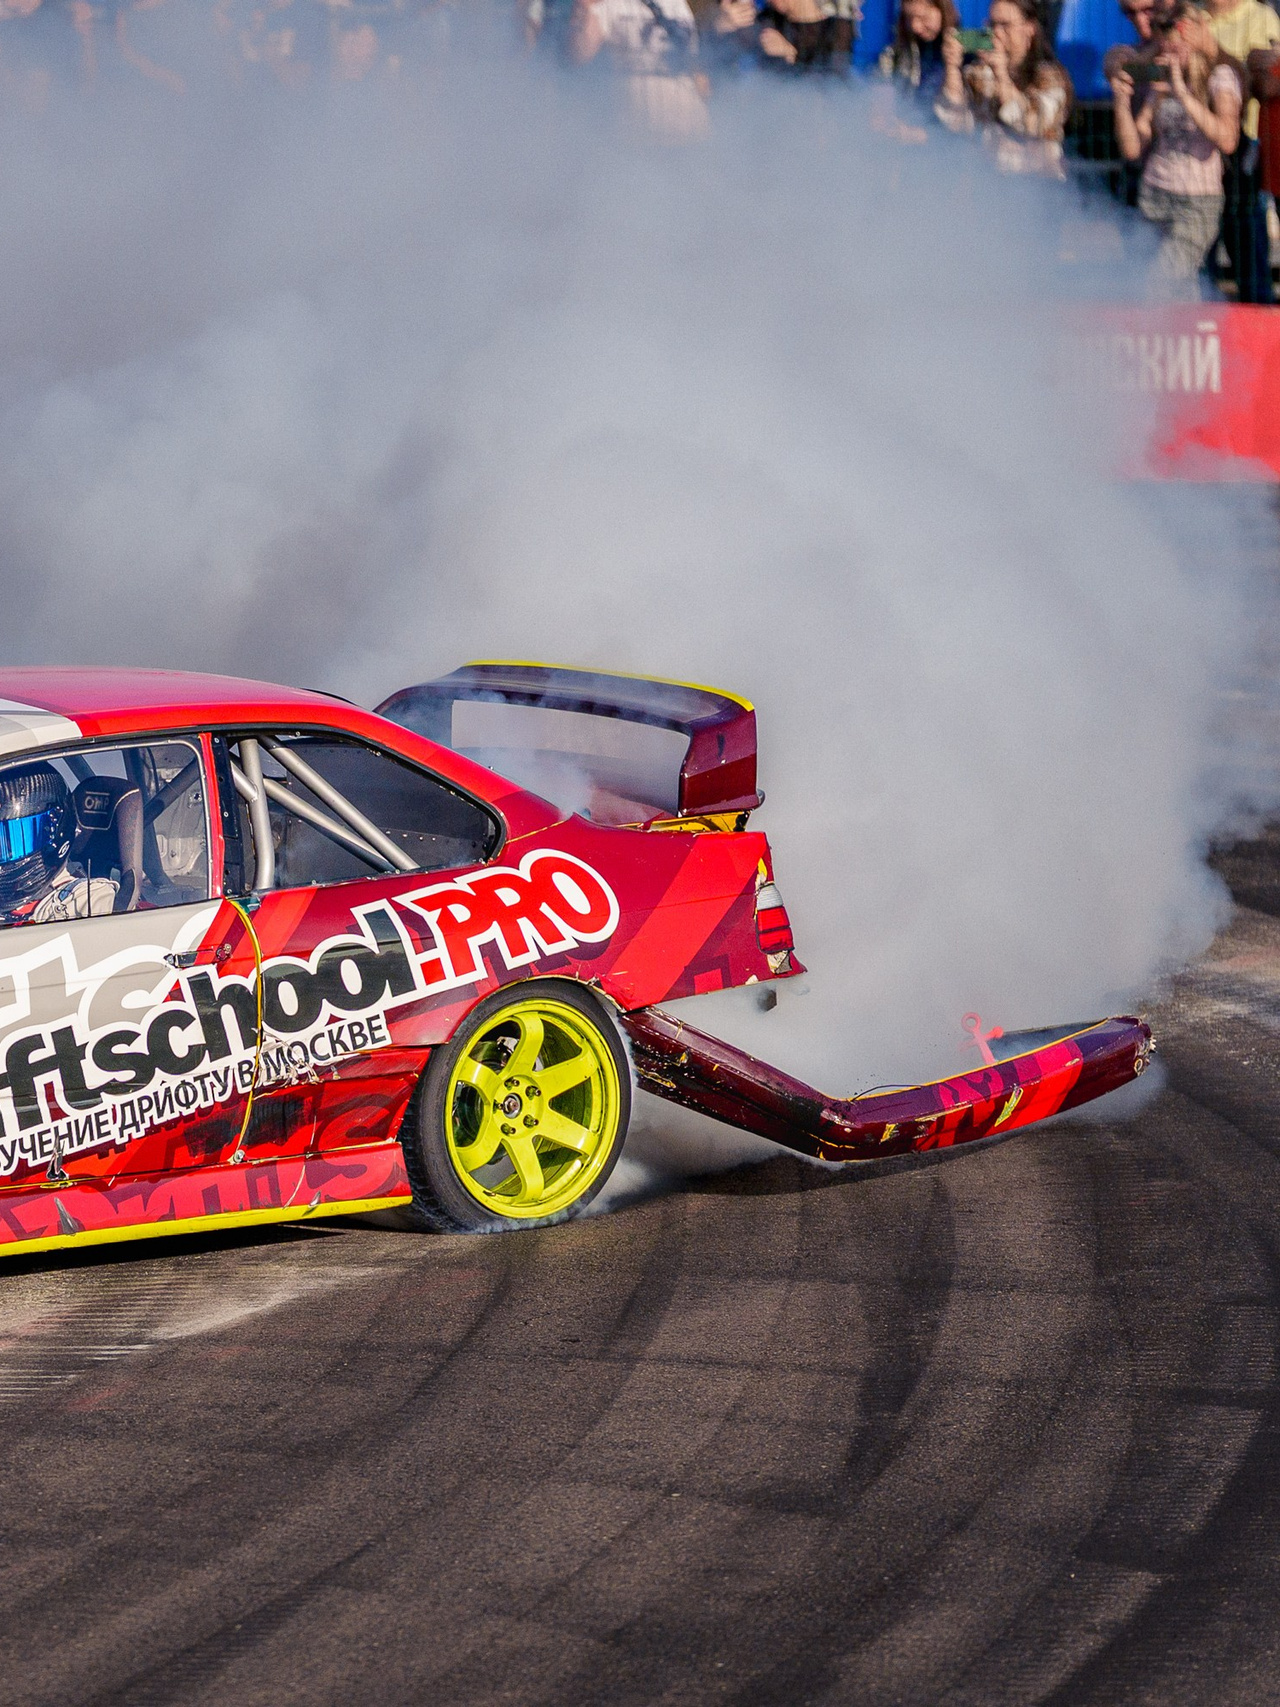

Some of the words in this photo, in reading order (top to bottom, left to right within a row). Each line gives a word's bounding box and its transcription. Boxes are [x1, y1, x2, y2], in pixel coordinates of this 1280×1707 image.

[119, 1065, 230, 1132] ДРИФТУ
[237, 1059, 254, 1088] В
[262, 1014, 387, 1082] МОСКВЕ
